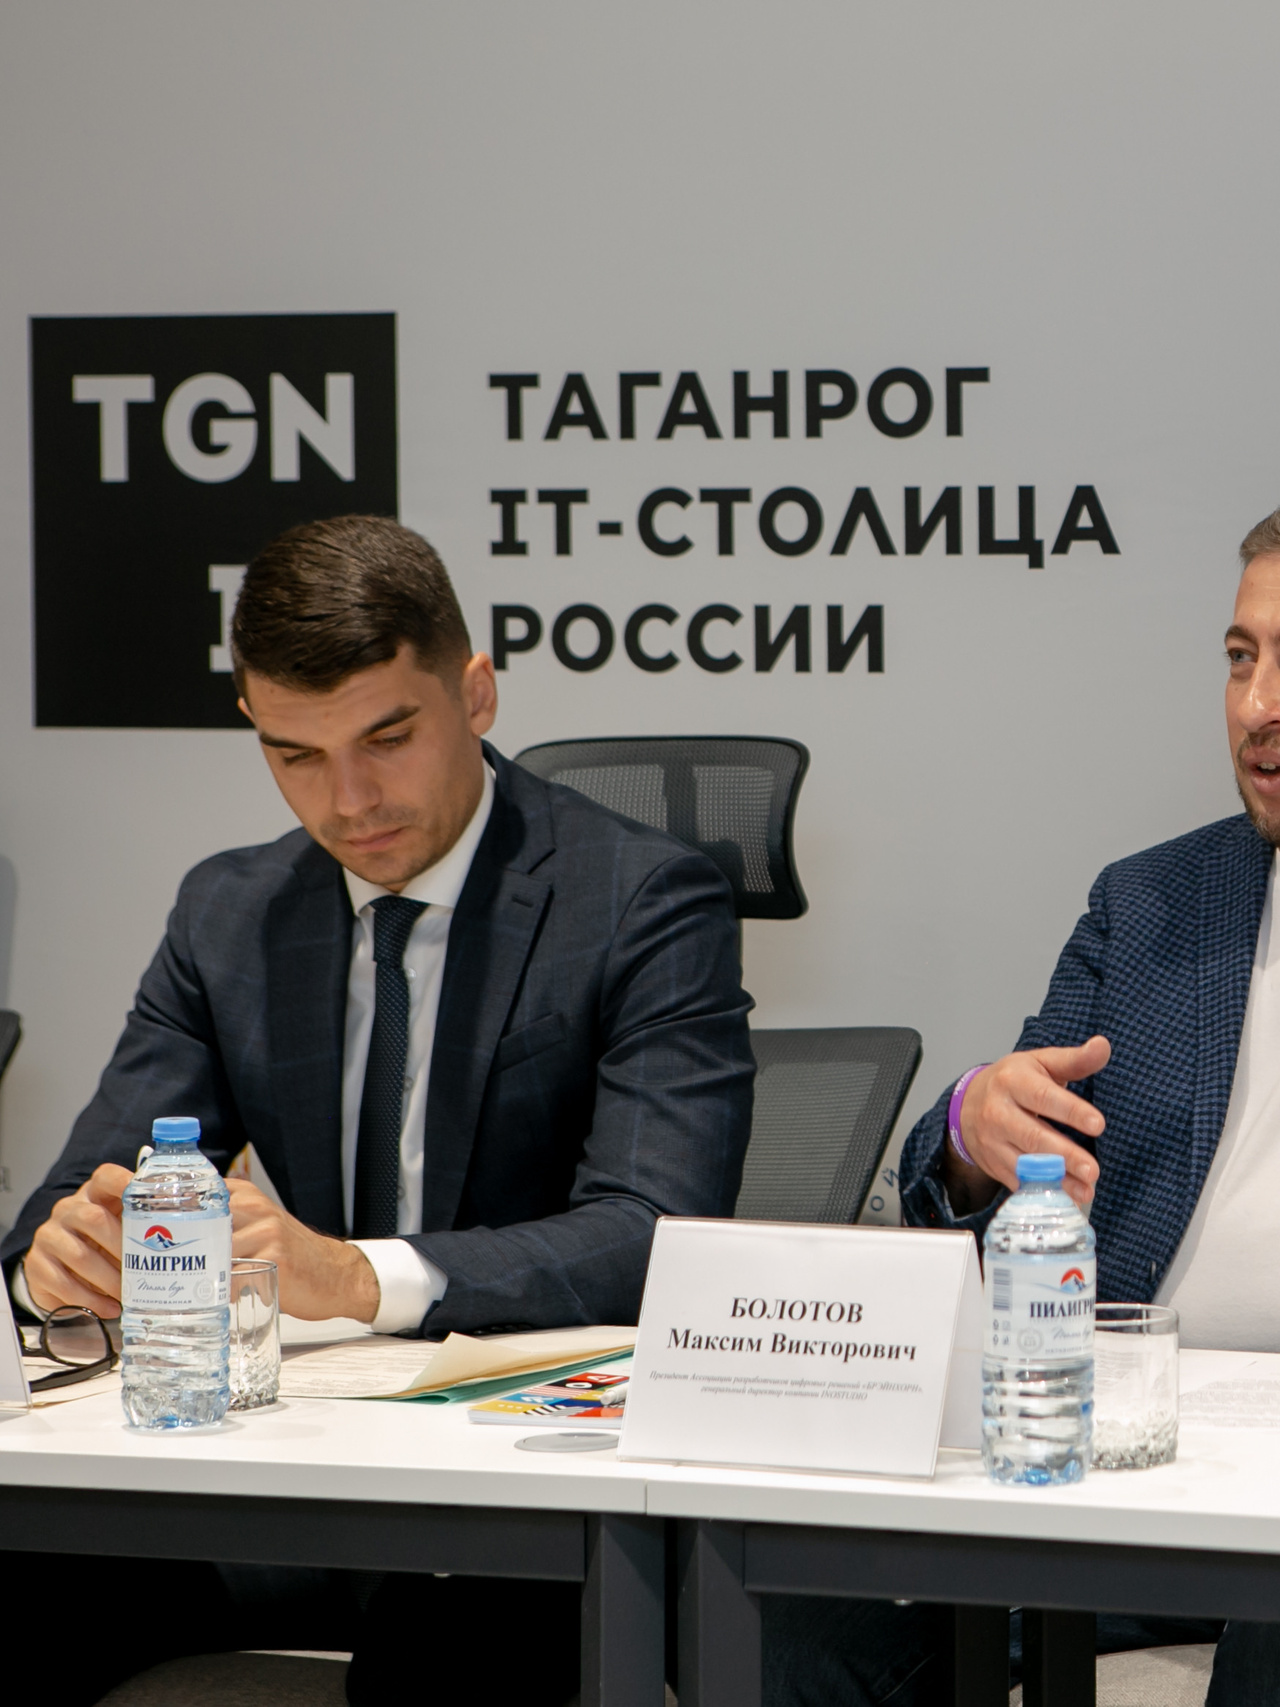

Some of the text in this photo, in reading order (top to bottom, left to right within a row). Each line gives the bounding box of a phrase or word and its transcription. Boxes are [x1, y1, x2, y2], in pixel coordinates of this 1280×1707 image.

[72, 371, 356, 484] TGN
[487, 365, 991, 441] ТАГАНРОГ
[488, 484, 1122, 570] IT-СТОЛИЦА
[490, 603, 886, 674] РОССИИ
[124, 1253, 206, 1272] ПИЛИГРИМ
[730, 1297, 863, 1324] БОЛОТОВ
[667, 1328, 917, 1363] Максим Викторович
[820, 1389, 868, 1401] INOSTUDIO
